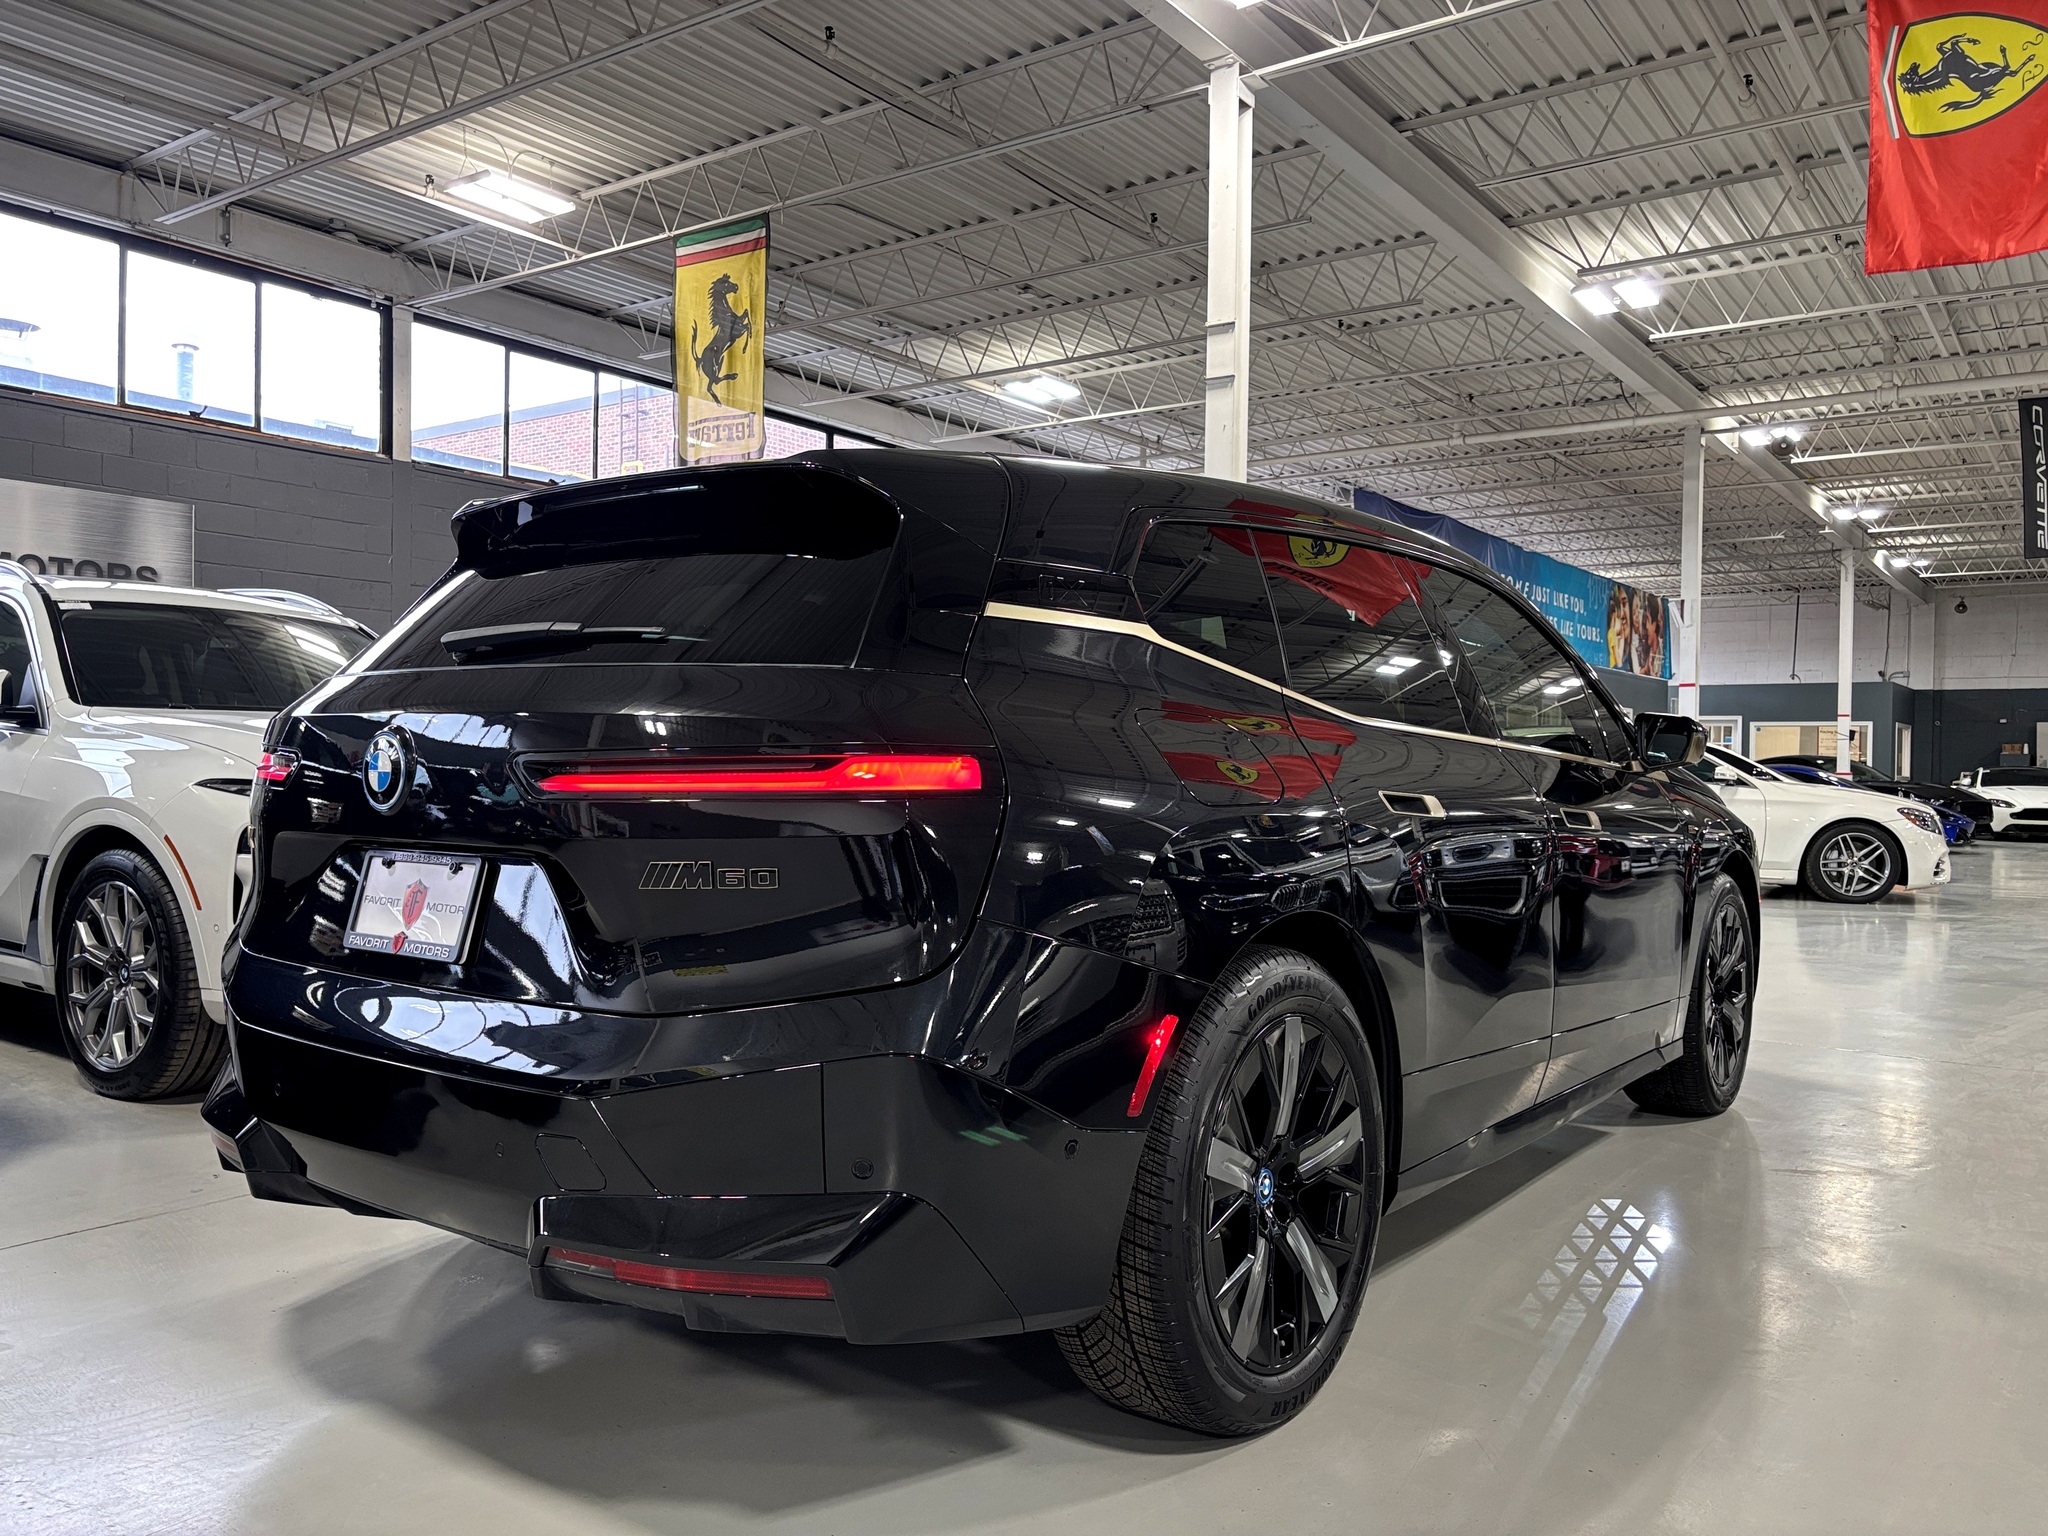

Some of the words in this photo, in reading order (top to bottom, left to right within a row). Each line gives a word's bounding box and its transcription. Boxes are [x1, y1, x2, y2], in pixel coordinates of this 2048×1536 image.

[2032, 405, 2048, 551] CORVETTE
[0, 551, 158, 583] OTORS
[1531, 584, 1550, 604] JUST
[1553, 592, 1569, 611] LIKE
[1560, 619, 1574, 637] LIKE
[1576, 624, 1604, 643] YOURS.
[364, 895, 401, 907] FAVORIT
[348, 935, 390, 949] FAVORIT
[403, 943, 450, 959] MOTORS
